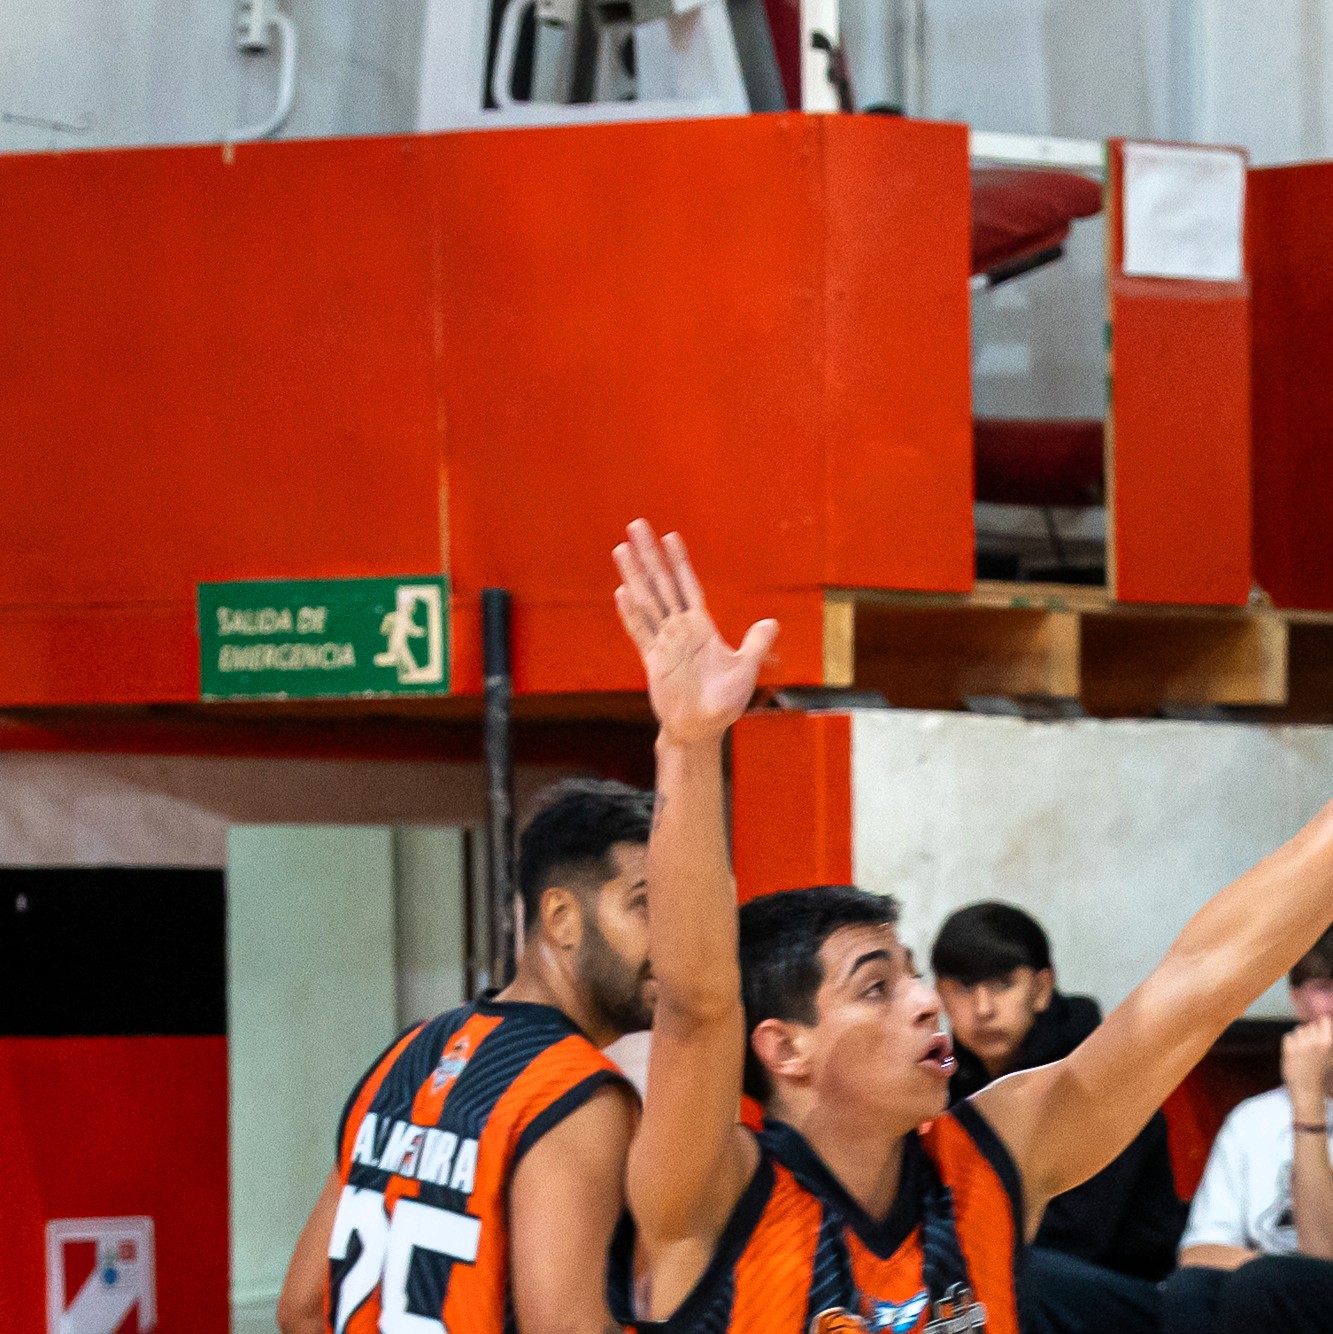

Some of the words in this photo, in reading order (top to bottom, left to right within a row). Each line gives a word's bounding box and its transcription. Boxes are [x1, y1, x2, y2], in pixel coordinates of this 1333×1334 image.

[216, 606, 293, 636] SALIDA
[297, 606, 329, 634] DE
[218, 642, 356, 672] EMERGENCIA
